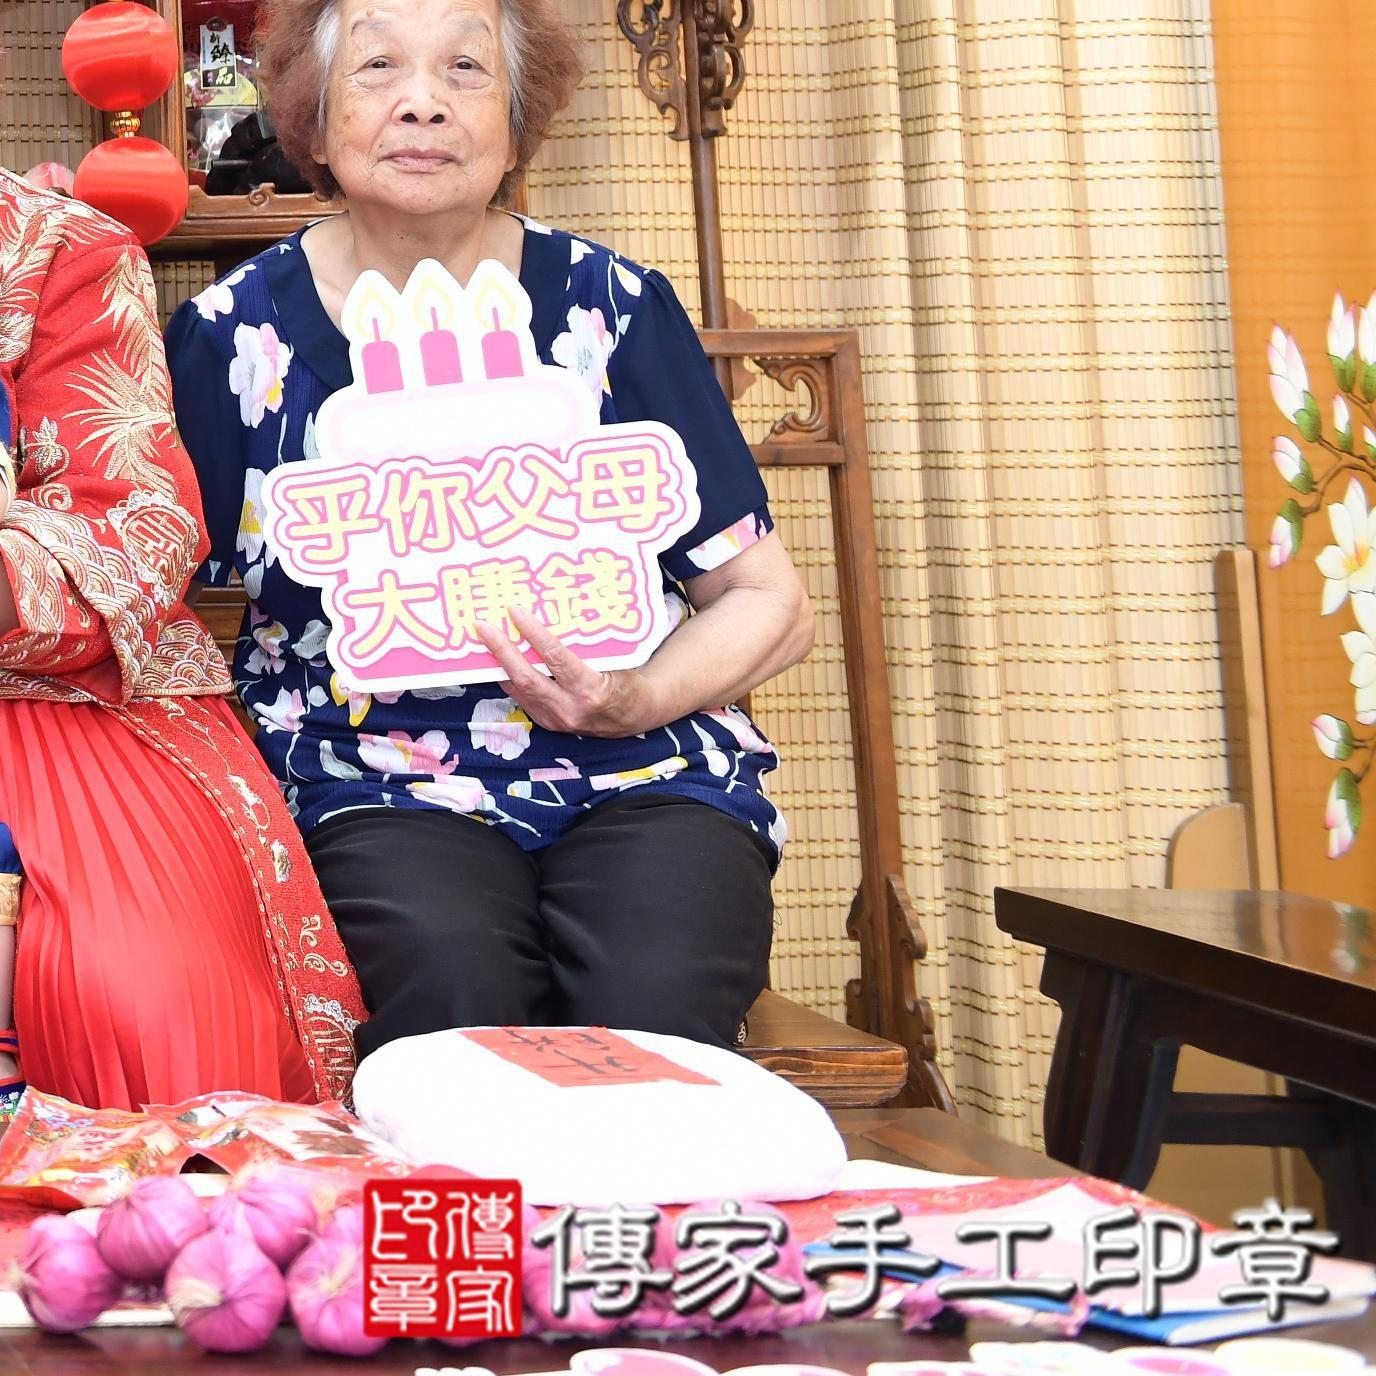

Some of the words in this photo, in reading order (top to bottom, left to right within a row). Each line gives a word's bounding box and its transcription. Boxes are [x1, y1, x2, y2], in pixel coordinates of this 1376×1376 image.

[285, 446, 671, 563] 乎你父母
[348, 549, 639, 656] 大賺錢
